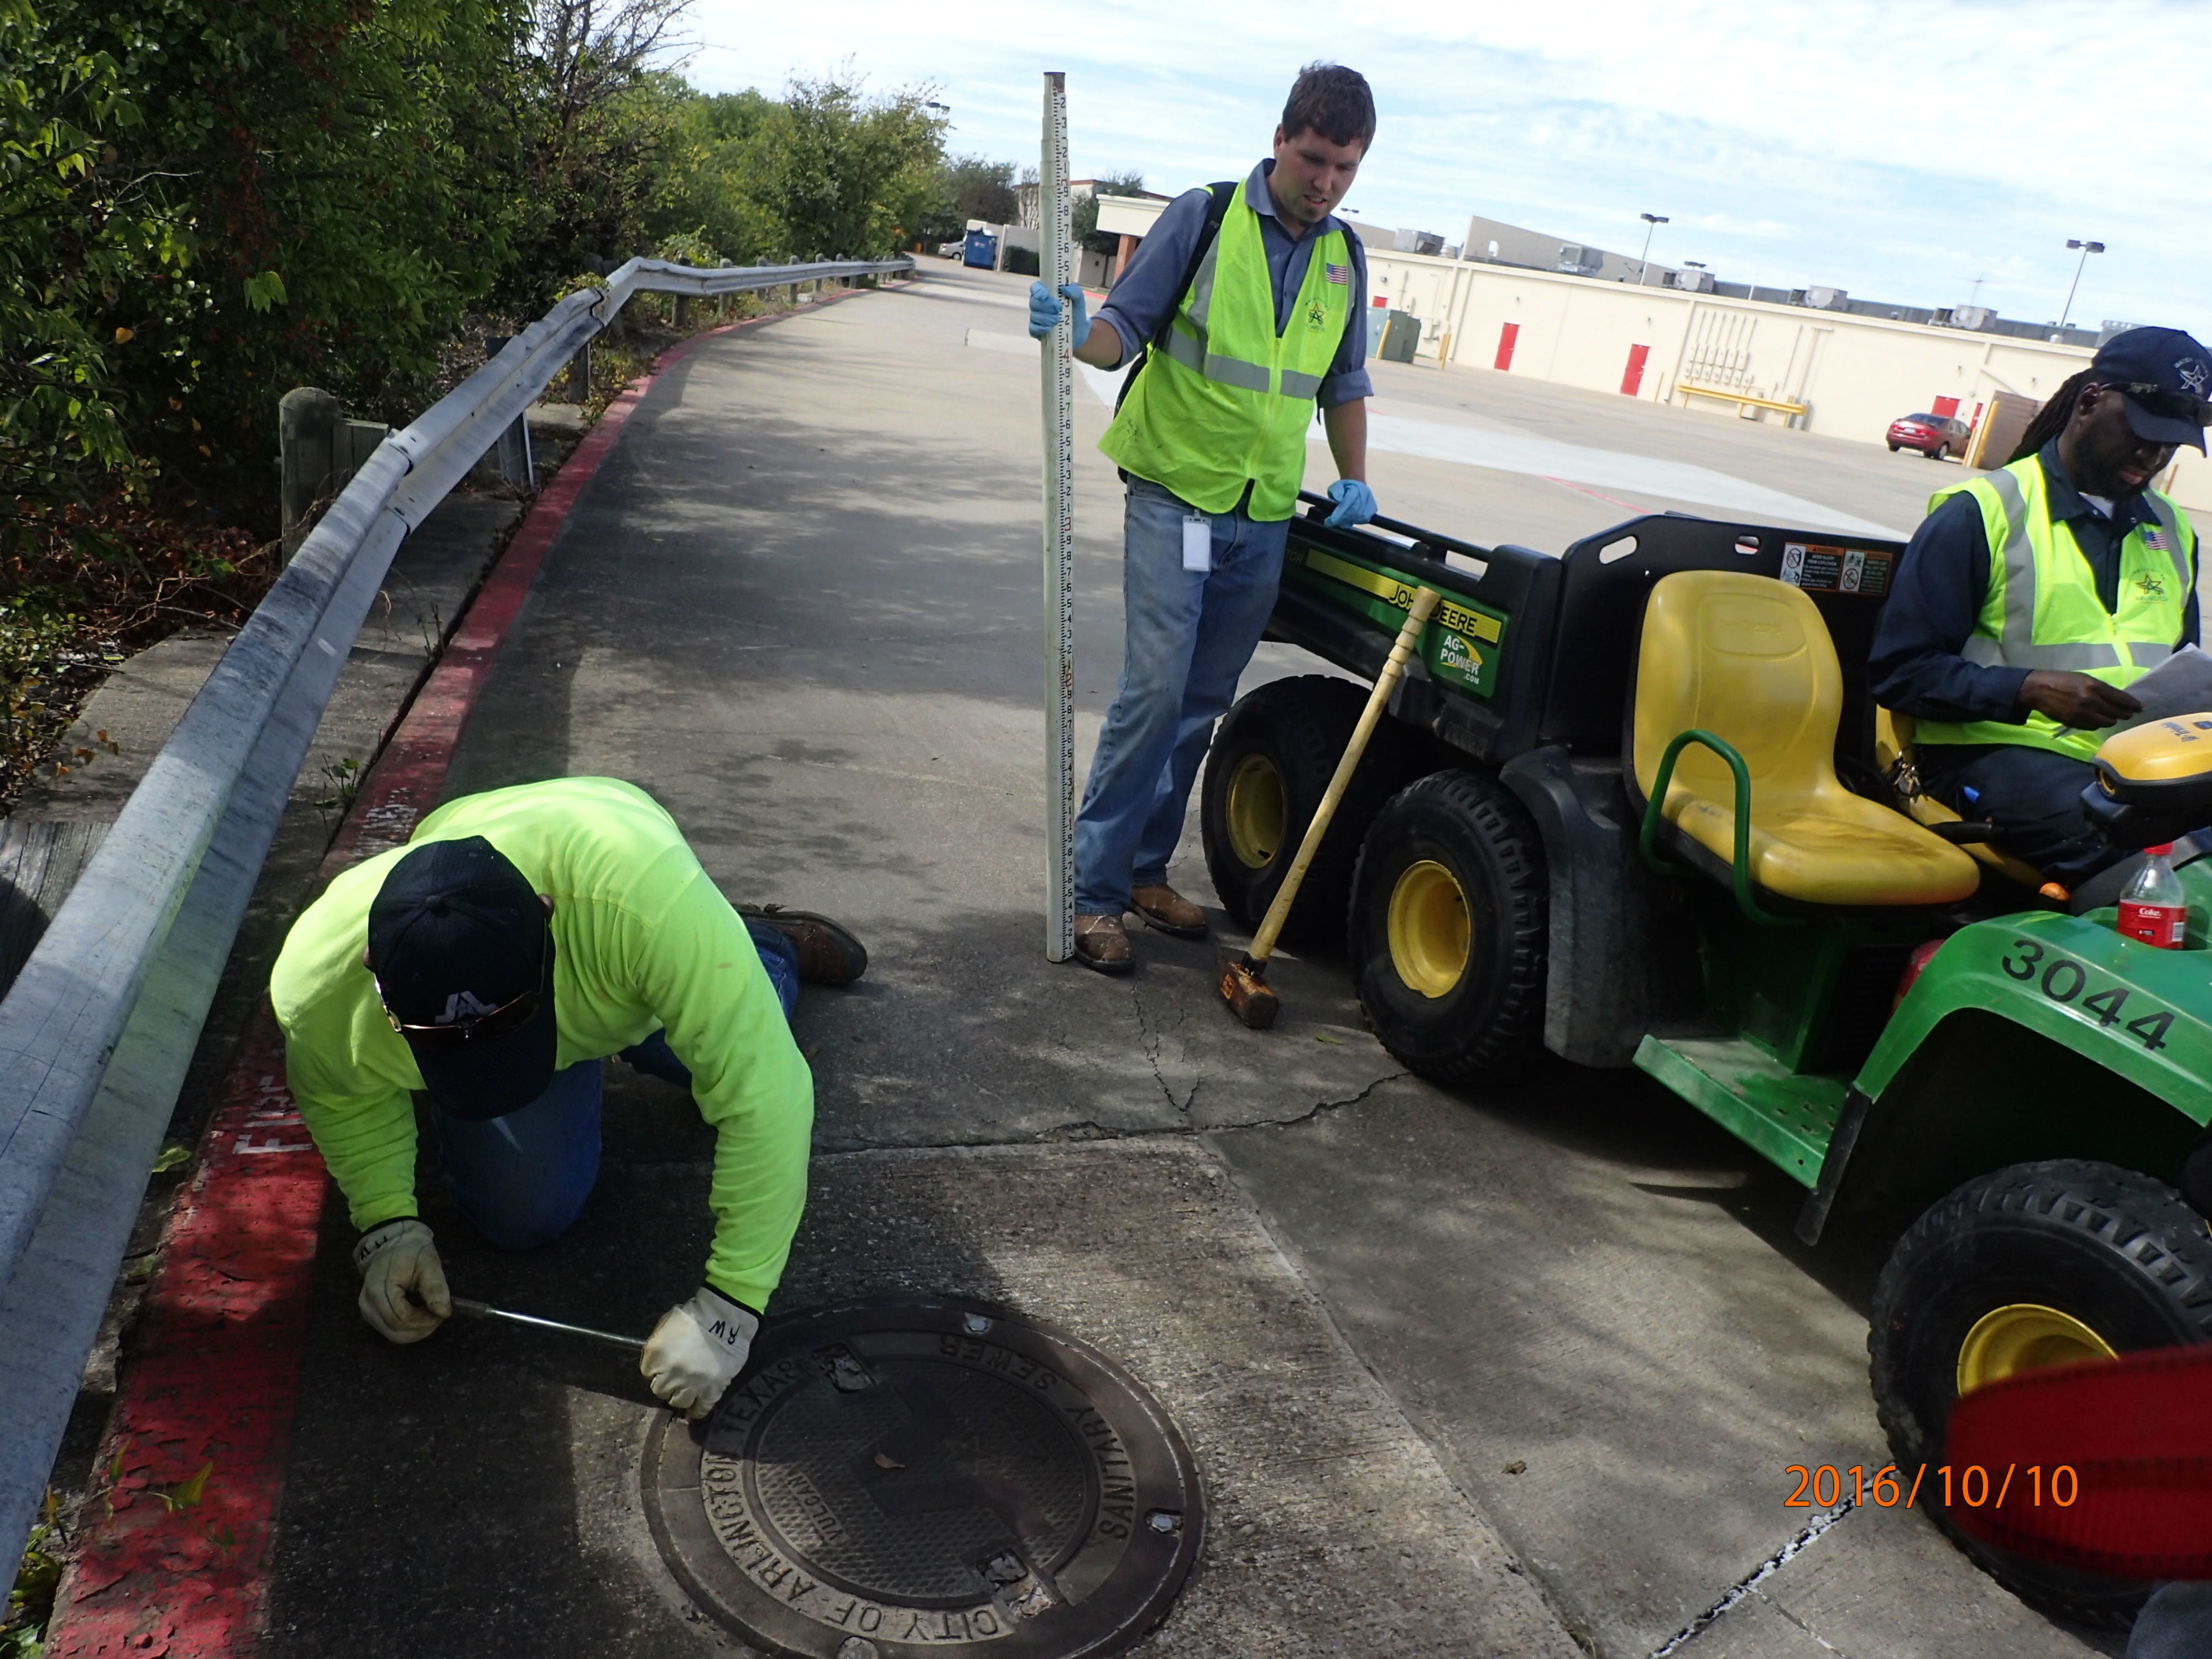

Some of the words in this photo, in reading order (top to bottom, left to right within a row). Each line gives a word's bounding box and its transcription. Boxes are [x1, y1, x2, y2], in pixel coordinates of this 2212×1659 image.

[1060, 97, 1066, 108] 2
[1062, 117, 1067, 128] 3
[1062, 147, 1067, 158] 2
[1063, 187, 1068, 197] 9
[1063, 206, 1068, 216] 8
[1064, 225, 1068, 234] 7
[1064, 243, 1069, 253] 6
[1064, 261, 1069, 271] 5
[1065, 315, 1070, 325] 2
[1064, 348, 1070, 363] 4
[1065, 368, 1070, 378] 9
[1065, 385, 1070, 395] 8
[1066, 403, 1071, 412] 7
[1066, 420, 1071, 429] 6
[1066, 437, 1071, 446] 5
[1066, 453, 1071, 462] 4
[1066, 470, 1071, 479] 3
[1066, 487, 1071, 495] 2
[1065, 517, 1071, 531] 3
[1066, 535, 1071, 545] 9
[1066, 551, 1071, 560] 8
[1067, 567, 1071, 576] 7
[1067, 583, 1072, 592] 6
[1389, 585, 1414, 607] JOH
[1067, 599, 1072, 608] 5
[1067, 614, 1072, 623] 4
[1067, 630, 1072, 639] 3
[1443, 635, 1464, 651] AG-
[1067, 645, 1072, 654] 2
[1440, 648, 1479, 676] POWER
[1463, 673, 1479, 685] .COM
[1067, 690, 1072, 699] 9
[1067, 705, 1072, 713] 8
[1067, 720, 1072, 728] 7
[1067, 749, 1072, 758] 5
[1067, 763, 1072, 771] 4
[1068, 778, 1072, 786] 3
[1068, 792, 1072, 800] 2
[1068, 834, 1072, 842] 9
[1068, 848, 1072, 856] 8
[1068, 862, 1072, 870] 7
[1068, 875, 1072, 884] 6
[1068, 889, 1072, 897] 5
[1068, 902, 1072, 910] 4
[1068, 915, 1073, 924] 3
[1068, 928, 1073, 937] 2
[2001, 940, 2176, 1051] 3044
[940, 1334, 1057, 1390] SEWER
[719, 1360, 796, 1433] TEXAS
[1063, 1406, 1135, 1540] SANITARY
[787, 1475, 844, 1541] VULCAN
[703, 1451, 817, 1601] ARLINGTON
[823, 1600, 883, 1632] OF
[903, 1609, 998, 1640] CITY
